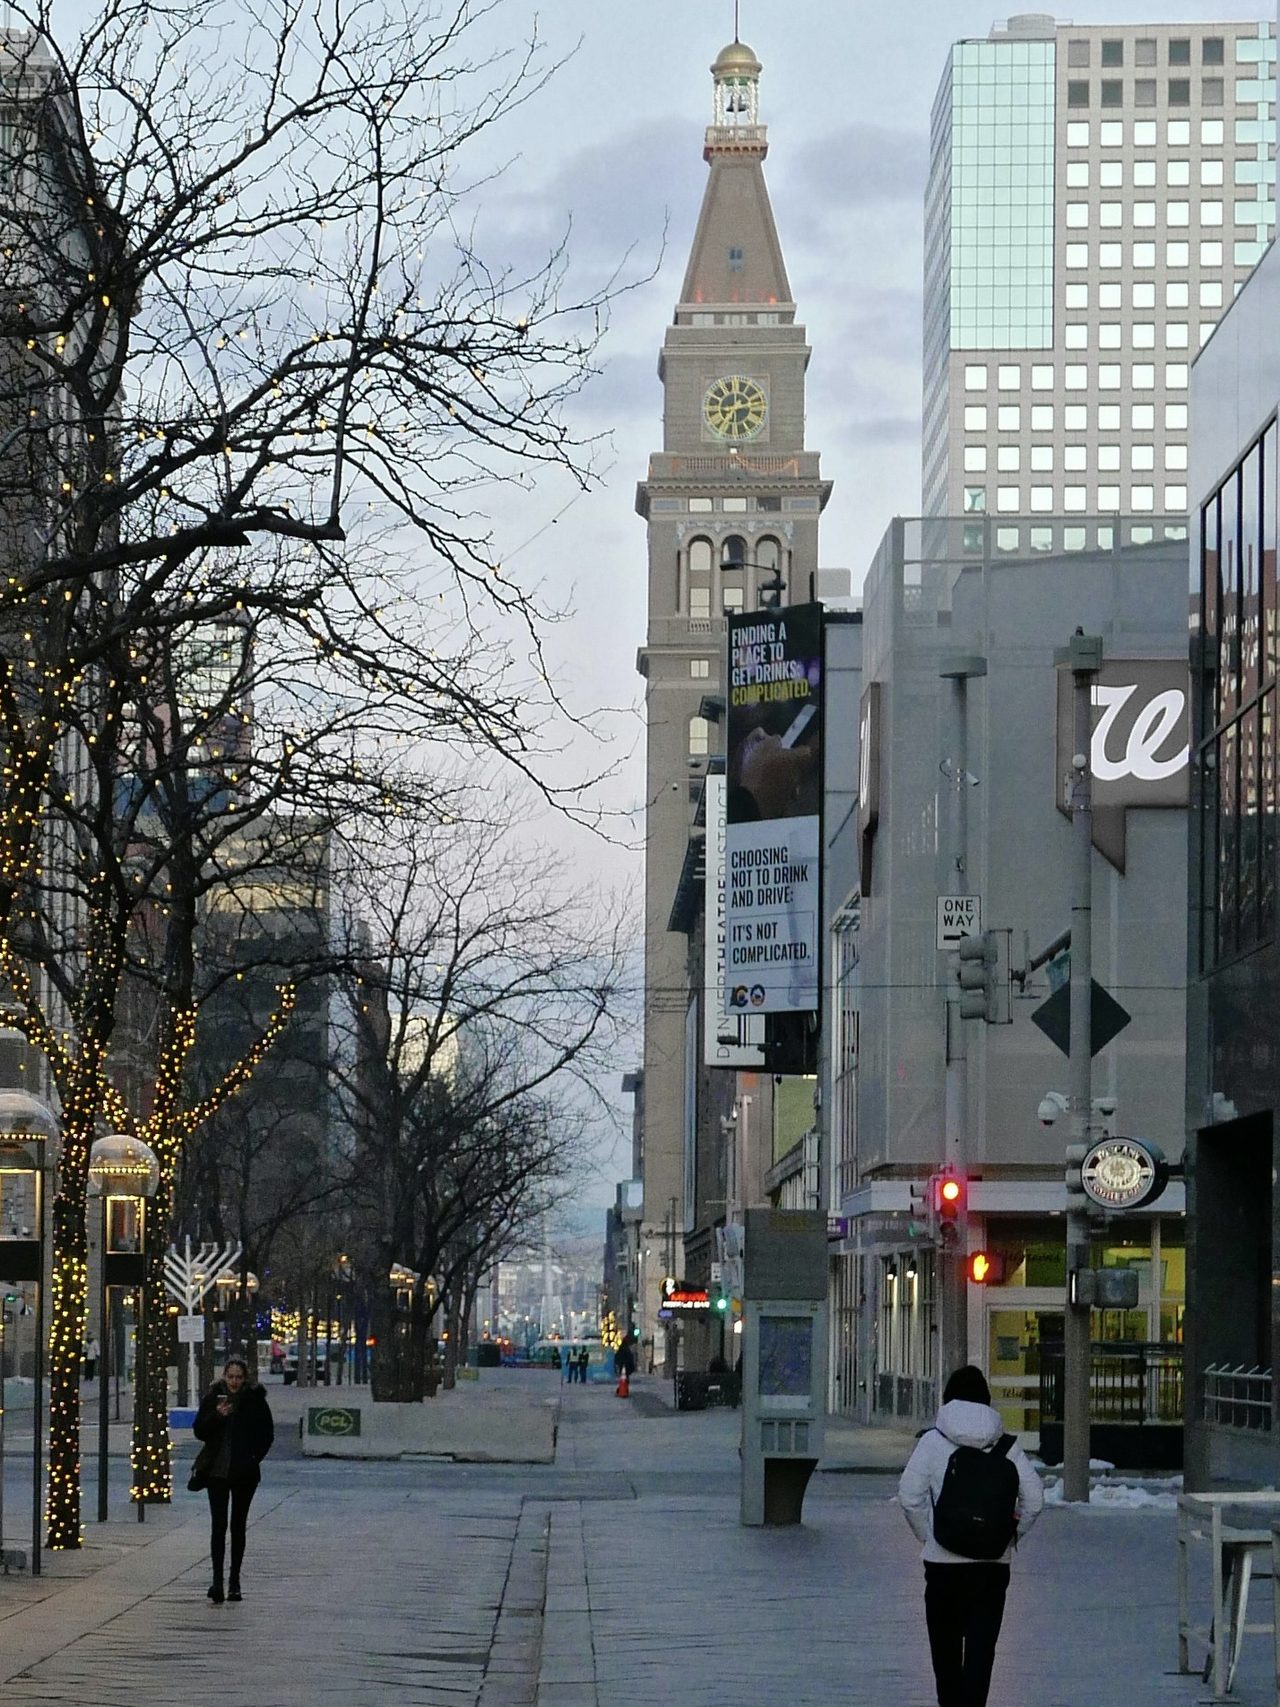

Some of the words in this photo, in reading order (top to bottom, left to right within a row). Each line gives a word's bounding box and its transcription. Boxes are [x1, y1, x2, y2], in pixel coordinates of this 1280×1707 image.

[732, 623, 775, 647] FINDING
[779, 621, 787, 640] A
[732, 644, 767, 667] PLACE
[769, 642, 784, 661] TO
[732, 666, 752, 686] GET
[756, 660, 801, 683] DRINKS:
[732, 679, 811, 705] COMPLICATED.
[731, 847, 788, 868] CHOOSING
[731, 869, 752, 888] NOT
[756, 868, 770, 885] TO
[774, 865, 808, 884] DRINK
[731, 888, 753, 908] AND
[757, 886, 794, 906] DRIVE:
[944, 900, 973, 911] ONE
[943, 914, 974, 926] WAY
[732, 923, 753, 942] IT'S
[756, 922, 778, 939] NOT
[732, 942, 810, 965] COMPLICATED.
[320, 1415, 348, 1427] PCL
